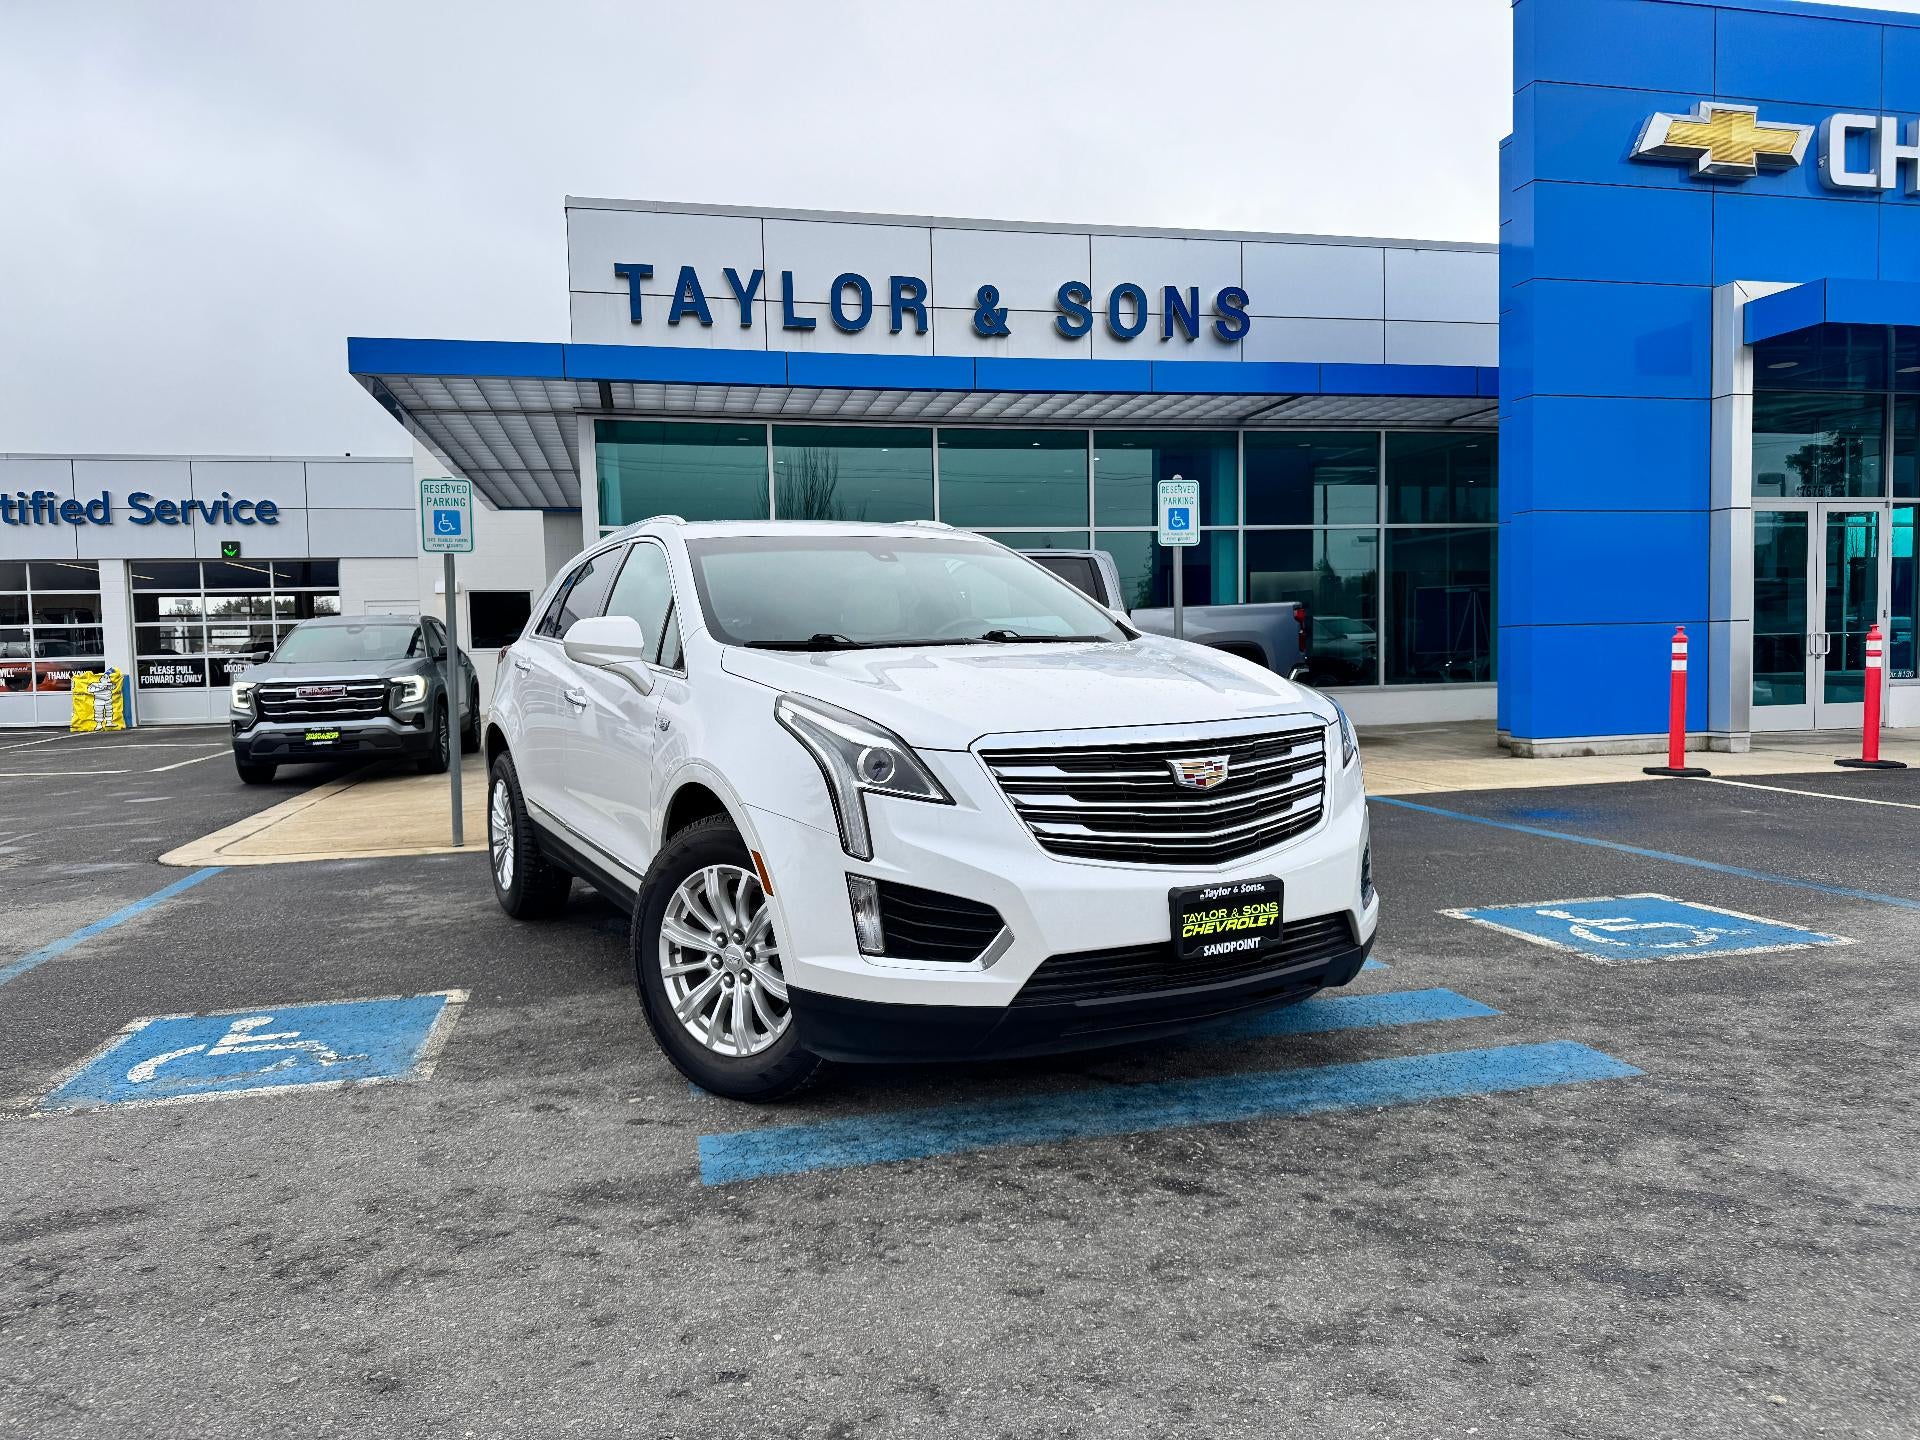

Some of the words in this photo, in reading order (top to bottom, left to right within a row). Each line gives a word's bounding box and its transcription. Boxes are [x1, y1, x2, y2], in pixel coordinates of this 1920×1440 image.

[614, 263, 929, 335] TAYLOR
[973, 284, 1011, 337] &
[1055, 280, 1251, 342] SONS
[424, 484, 468, 494] RESERVED
[1161, 485, 1196, 494] RESERVED
[426, 497, 466, 507] PARKING
[1163, 496, 1194, 505] PARKING
[127, 491, 280, 525] Service
[149, 666, 175, 675] PLEASE
[176, 665, 193, 674] PULL
[223, 664, 242, 673] DOOR
[46, 671, 71, 680] THANK
[140, 674, 174, 684] FORWARD
[175, 673, 203, 683] SLOWLY
[1203, 887, 1232, 899] Taylor
[1241, 882, 1262, 893] Sons
[1183, 908, 1228, 924] TAYLOR
[1231, 908, 1239, 918] &
[1243, 901, 1279, 916] SONS
[1183, 913, 1279, 938] CHEVROLET
[1203, 937, 1261, 956] SANDPOINT
